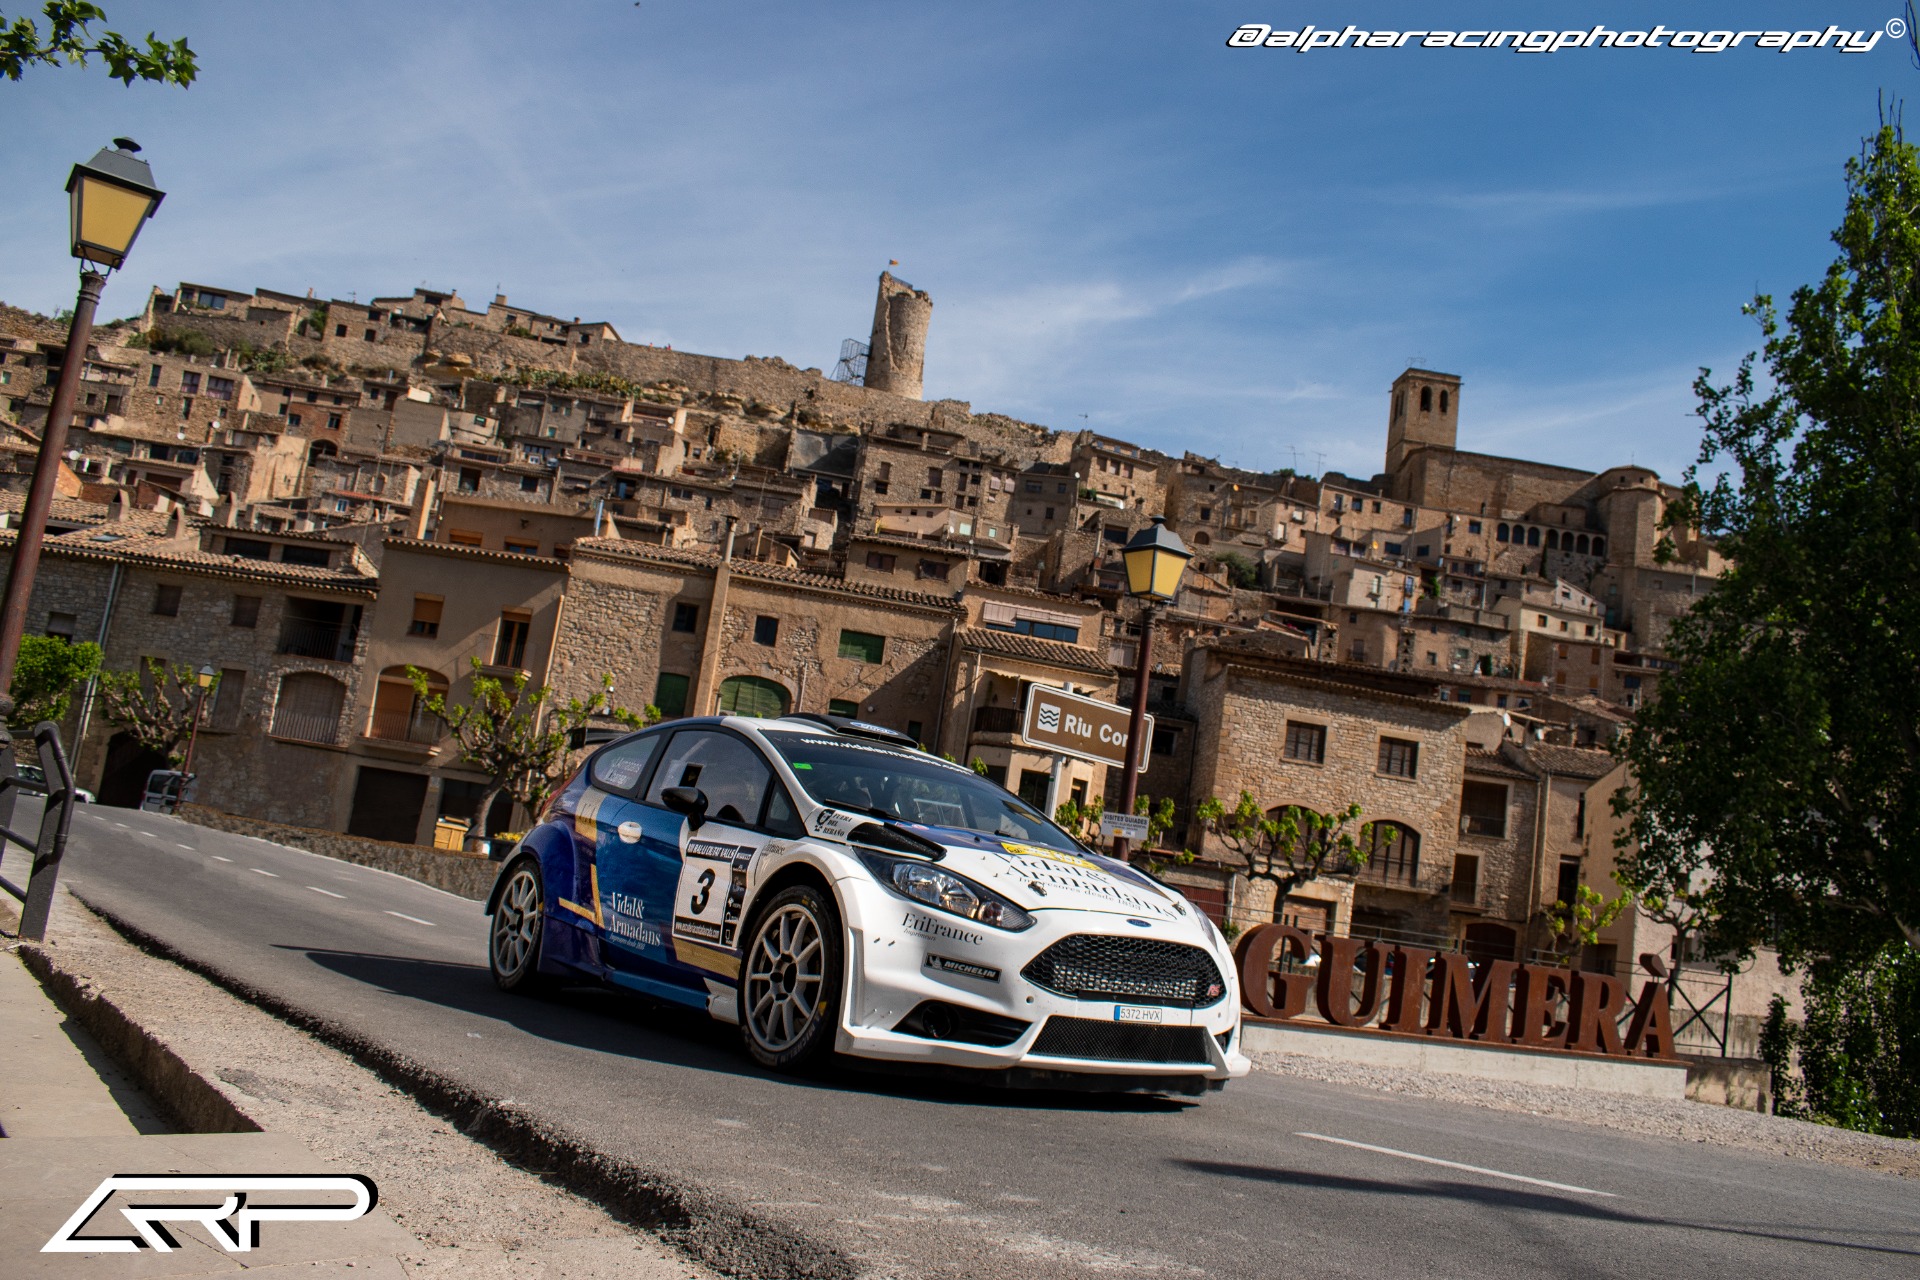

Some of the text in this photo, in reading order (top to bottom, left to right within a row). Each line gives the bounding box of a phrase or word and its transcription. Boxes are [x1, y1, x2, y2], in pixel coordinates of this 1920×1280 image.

[1064, 713, 1129, 748] Riu Cor
[827, 819, 839, 827] DEL
[1103, 814, 1124, 822] VISITES
[1124, 817, 1148, 825] GUIADES
[823, 827, 846, 837] REBAÑO
[690, 868, 716, 915] 3
[1004, 865, 1177, 920] Armadans
[1084, 889, 1115, 902] desde
[608, 914, 661, 947] Armadans
[902, 912, 983, 946] EtiFrance
[944, 960, 997, 978] MICHELIN
[1207, 983, 1221, 997] RS
[1234, 922, 1677, 1060] GUIMERÀ
[1120, 1007, 1161, 1021] 5372 HVX
